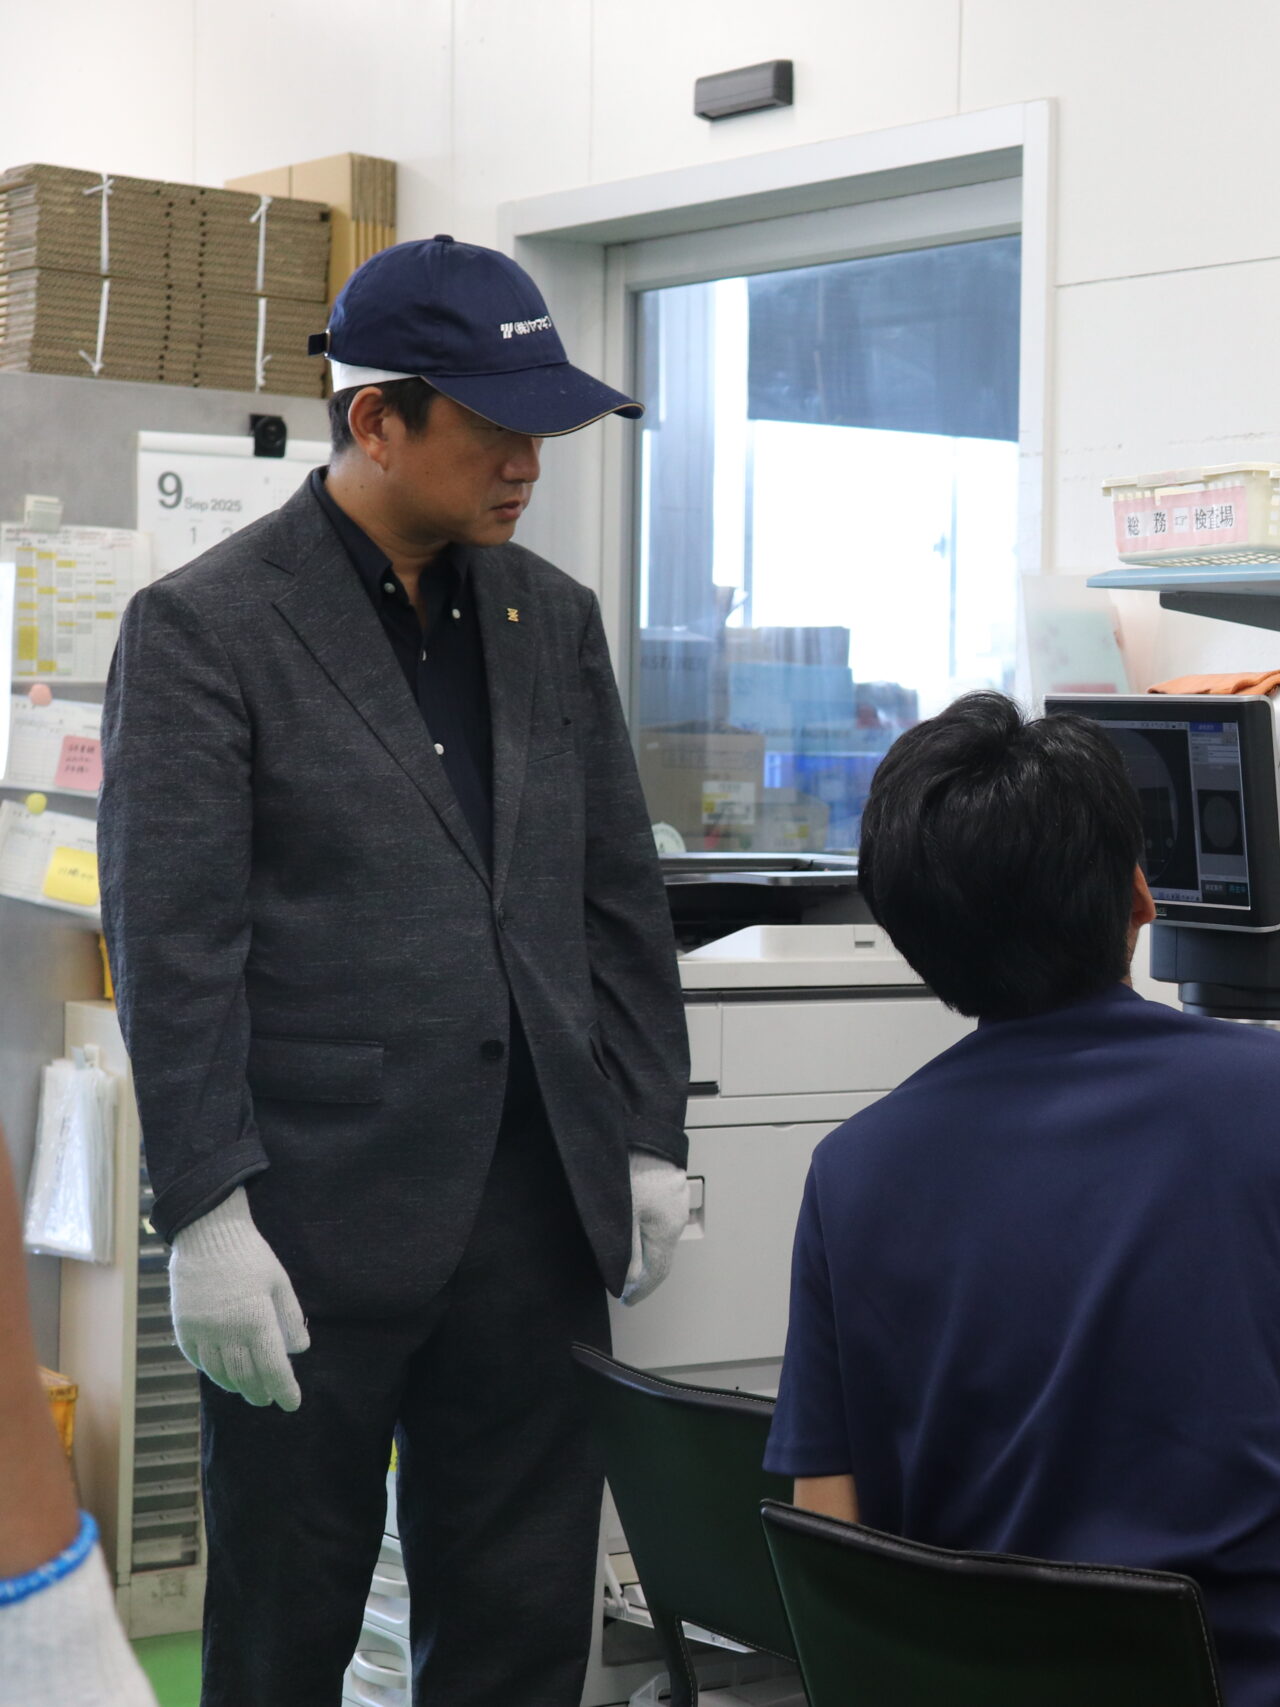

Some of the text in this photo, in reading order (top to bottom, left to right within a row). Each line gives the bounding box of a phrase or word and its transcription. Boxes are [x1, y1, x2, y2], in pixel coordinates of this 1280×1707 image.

[158, 471, 242, 512] 9 Sep 2025
[1194, 505, 1234, 530] 検査場
[189, 527, 197, 544] 1
